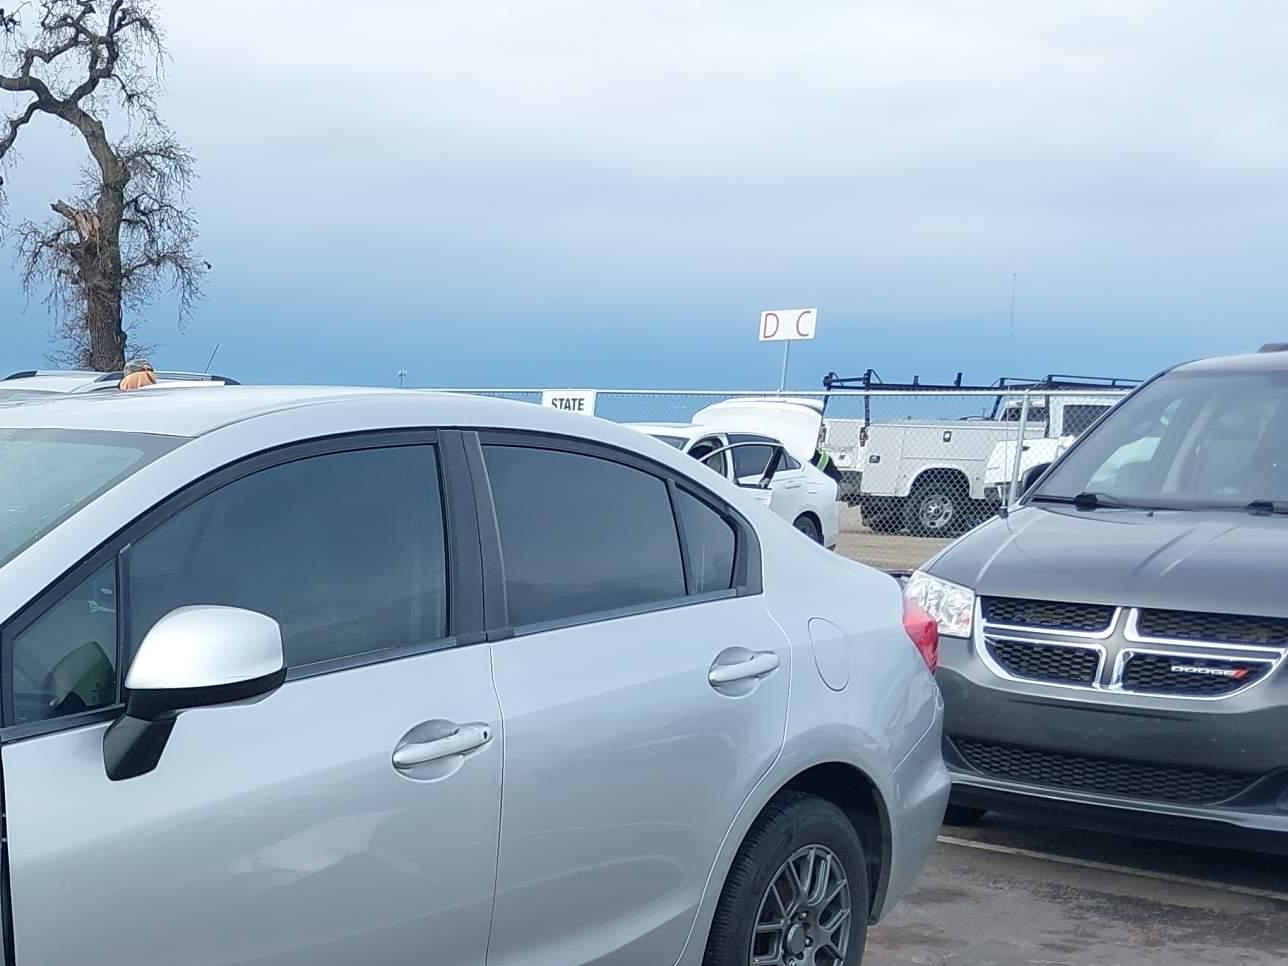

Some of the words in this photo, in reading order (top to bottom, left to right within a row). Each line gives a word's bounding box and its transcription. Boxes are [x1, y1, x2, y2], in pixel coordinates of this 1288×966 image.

[763, 312, 779, 338] D
[796, 310, 812, 337] C
[551, 397, 585, 411] STATE
[1171, 665, 1233, 677] DODGE
